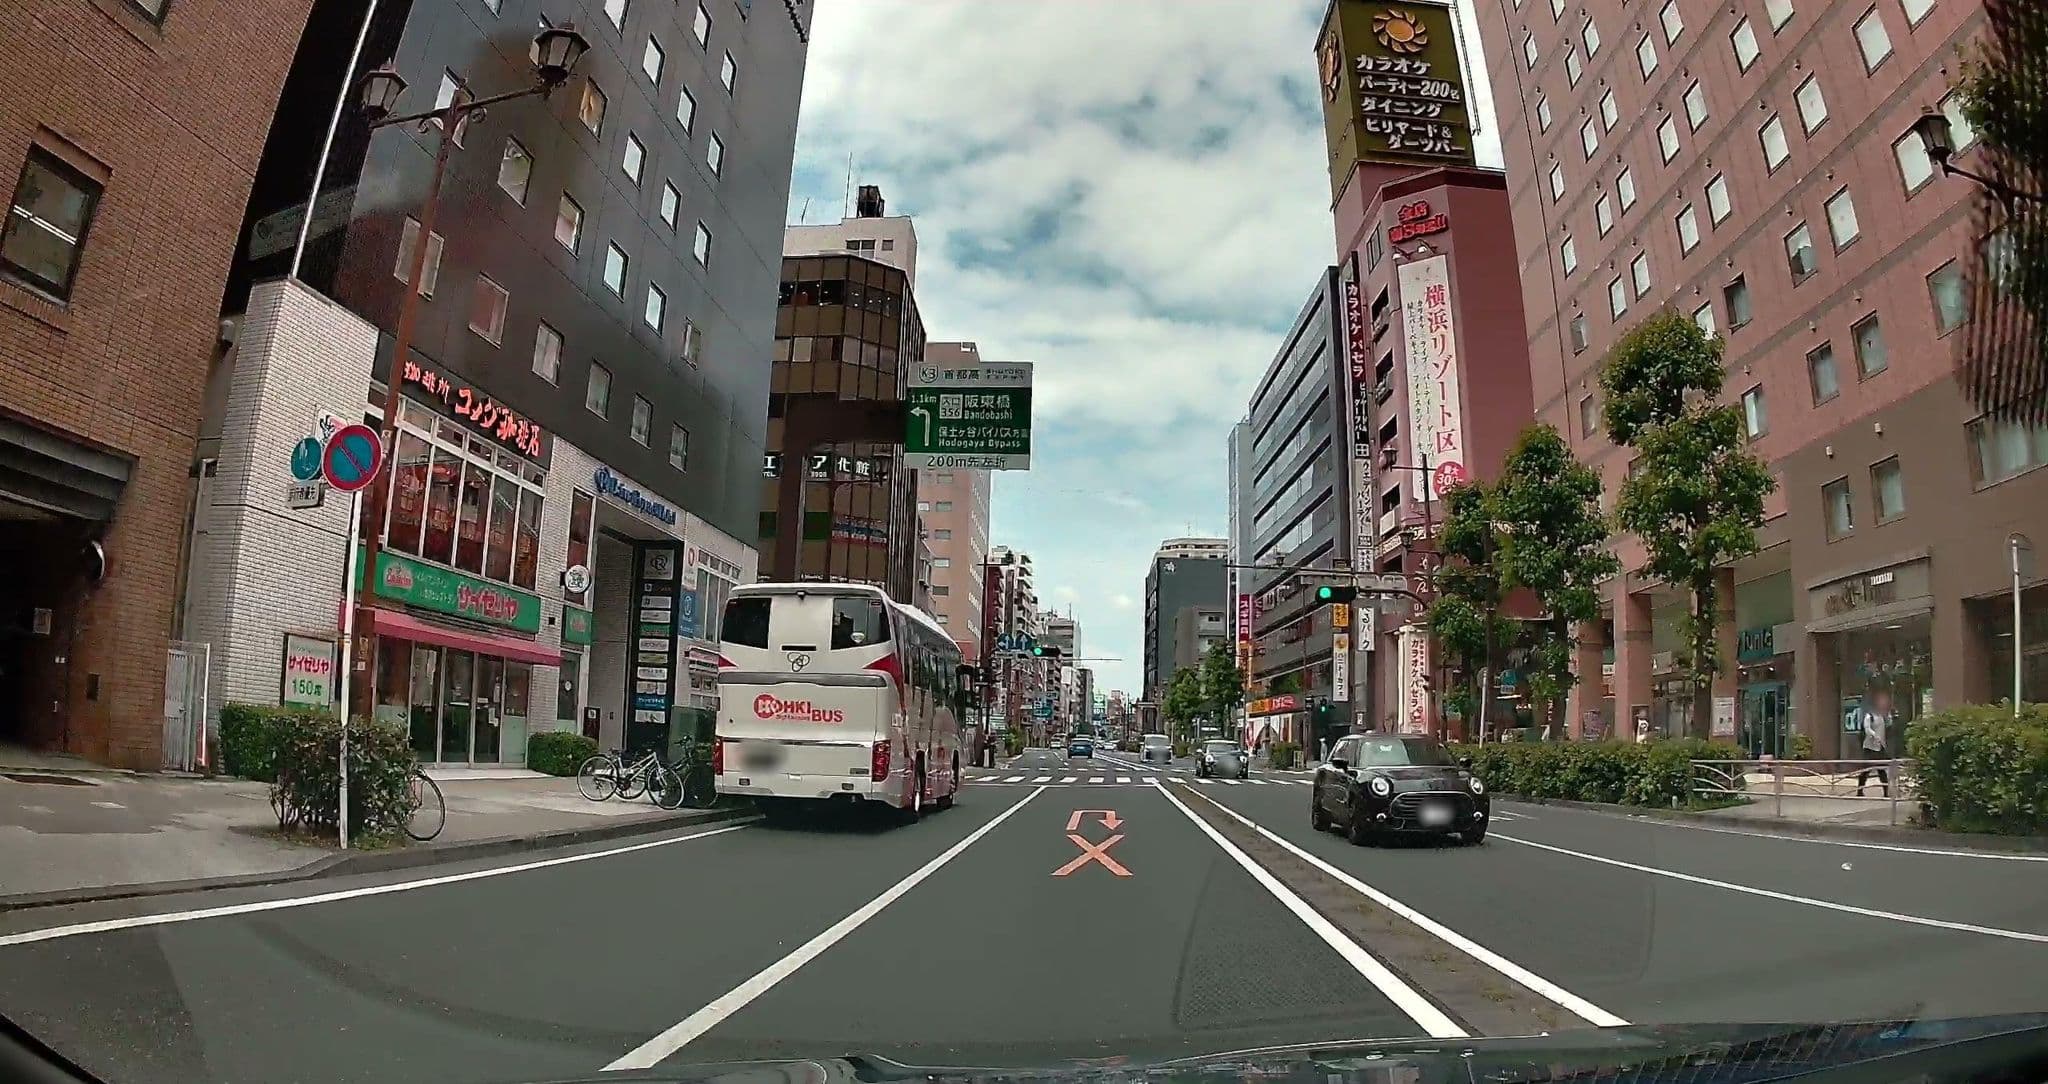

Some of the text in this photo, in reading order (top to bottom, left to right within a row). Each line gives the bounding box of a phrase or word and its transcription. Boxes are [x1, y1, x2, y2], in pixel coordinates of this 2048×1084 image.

[1356, 54, 1431, 75] カラオケ
[1361, 96, 1443, 118] ダイニング
[1388, 134, 1466, 153] ダーツバー
[1347, 284, 1364, 378] カラオケ パセラ
[921, 367, 936, 380] K3
[1425, 284, 1457, 454] 横浜リゾート区
[911, 394, 937, 403] 1.1km
[964, 395, 1010, 409] 阪東橋
[942, 408, 961, 417] 356
[964, 410, 1013, 420] Bandobashi
[938, 439, 1021, 449] Hodogaya Bypass
[811, 709, 843, 722] BUS
